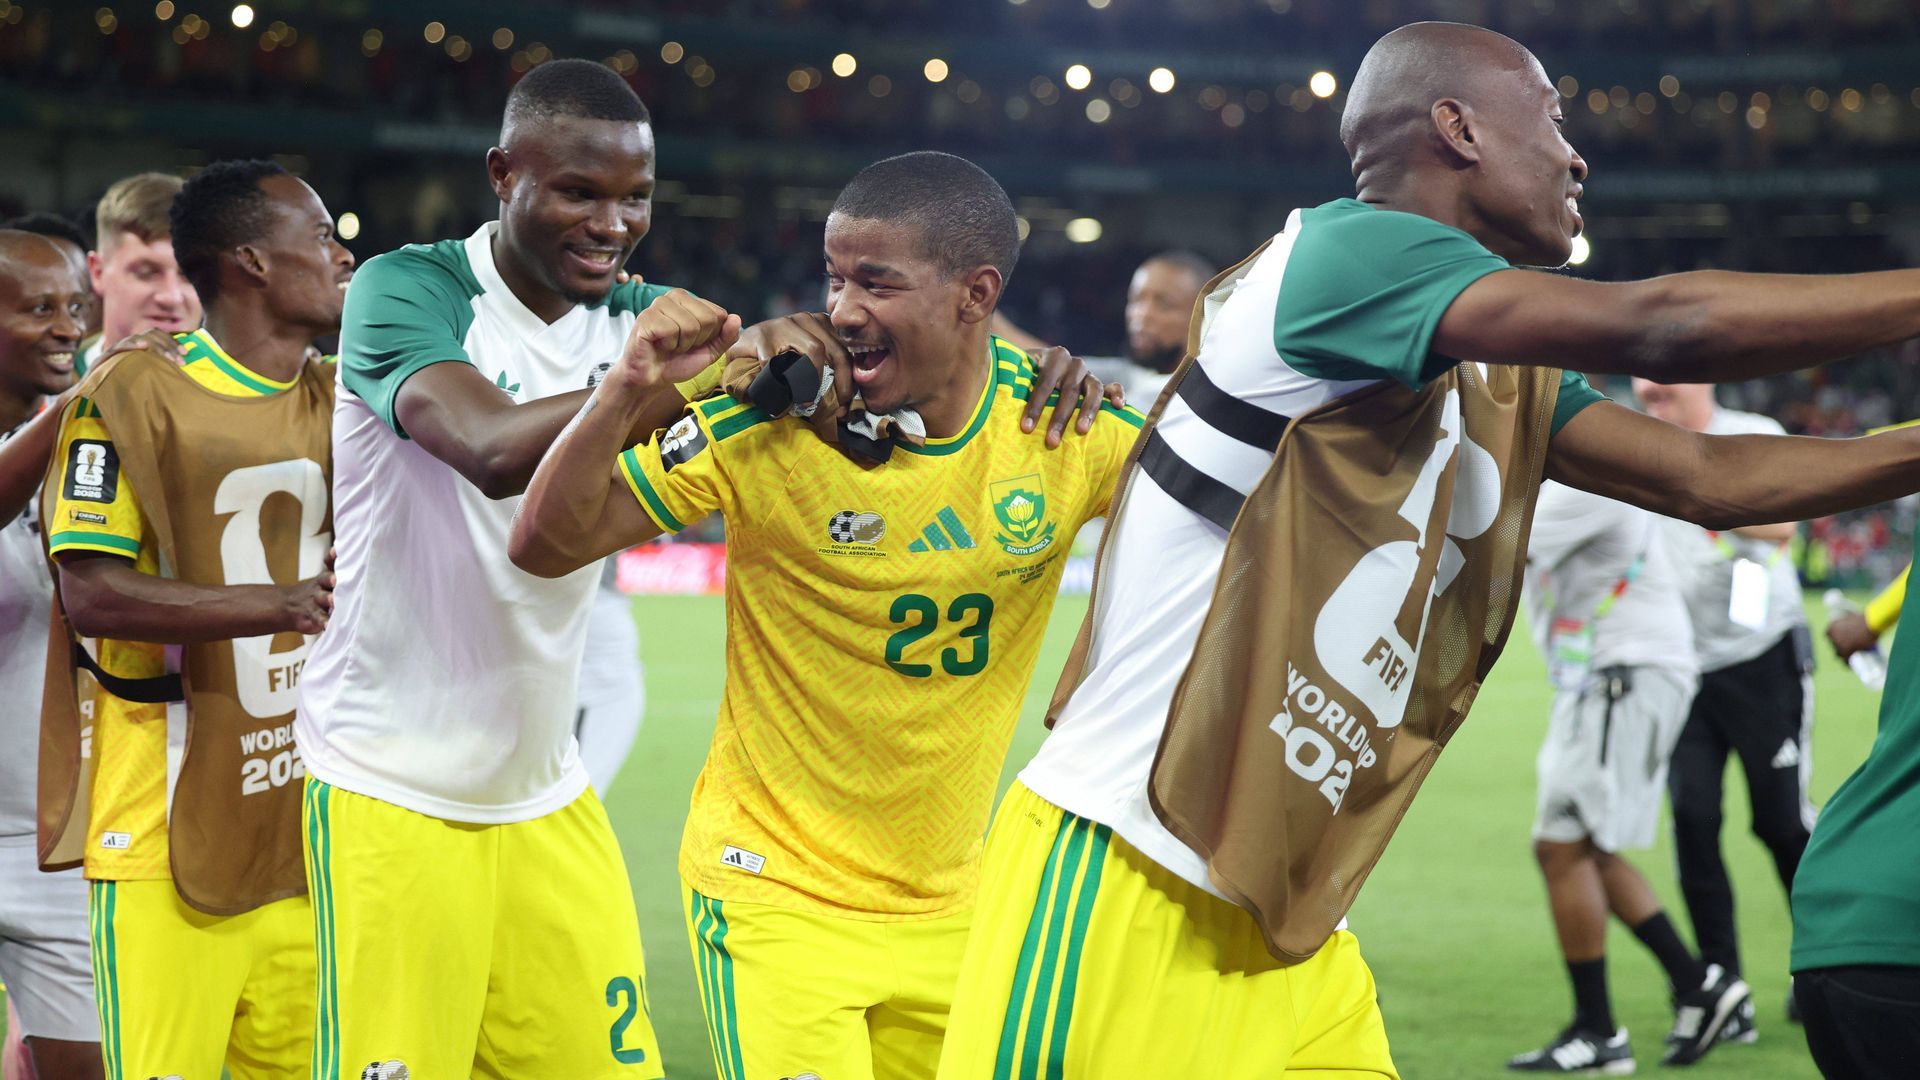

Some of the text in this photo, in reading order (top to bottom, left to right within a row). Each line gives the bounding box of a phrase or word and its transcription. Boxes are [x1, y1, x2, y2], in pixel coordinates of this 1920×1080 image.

[73, 489, 102, 499] 2026
[78, 512, 105, 521] DEBUT
[1006, 538, 1051, 555] SOUTH AFRICA
[996, 569, 1010, 577] SOUTH
[1011, 566, 1028, 575] AFRICA
[884, 593, 994, 678] 23
[268, 659, 306, 693] FIF
[1287, 660, 1367, 752] WORLD
